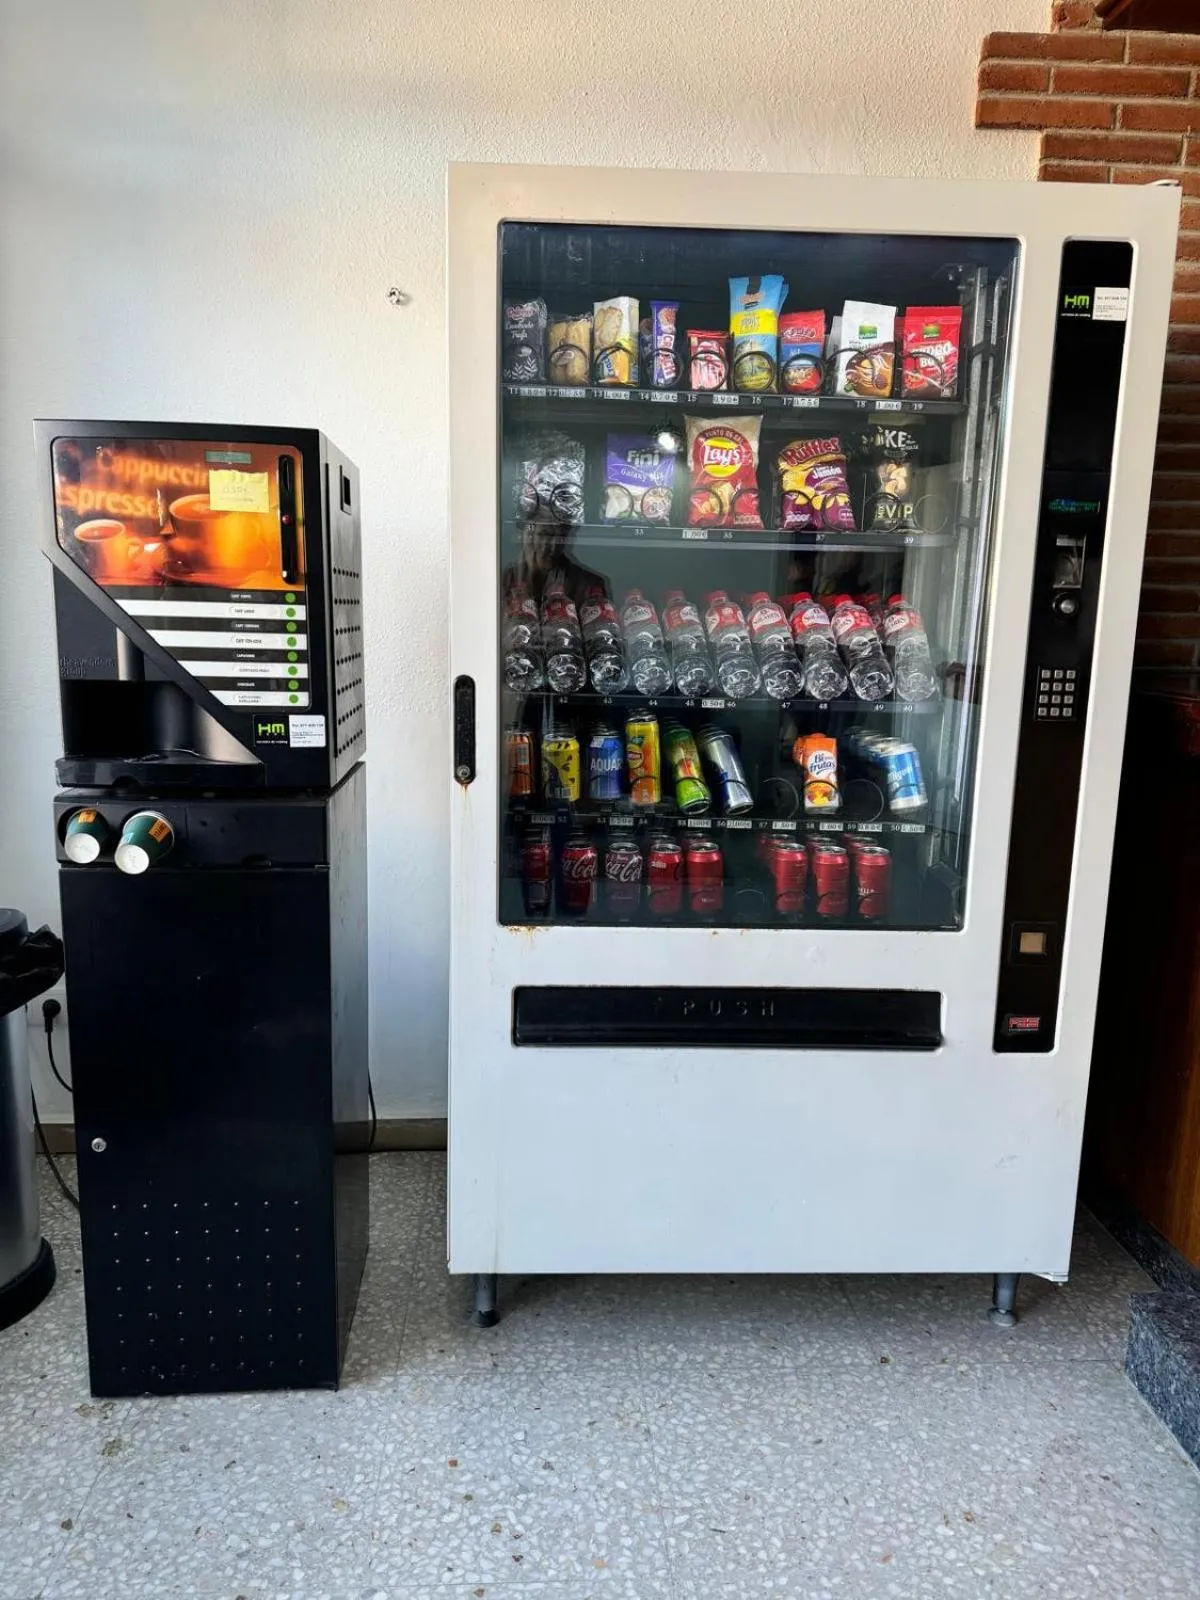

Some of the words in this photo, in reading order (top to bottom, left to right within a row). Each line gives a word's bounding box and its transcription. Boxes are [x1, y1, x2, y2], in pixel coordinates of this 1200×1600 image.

[1064, 295, 1090, 308] HM
[627, 450, 660, 466] Fini
[784, 437, 840, 467] Ruffles
[258, 723, 285, 736] HM
